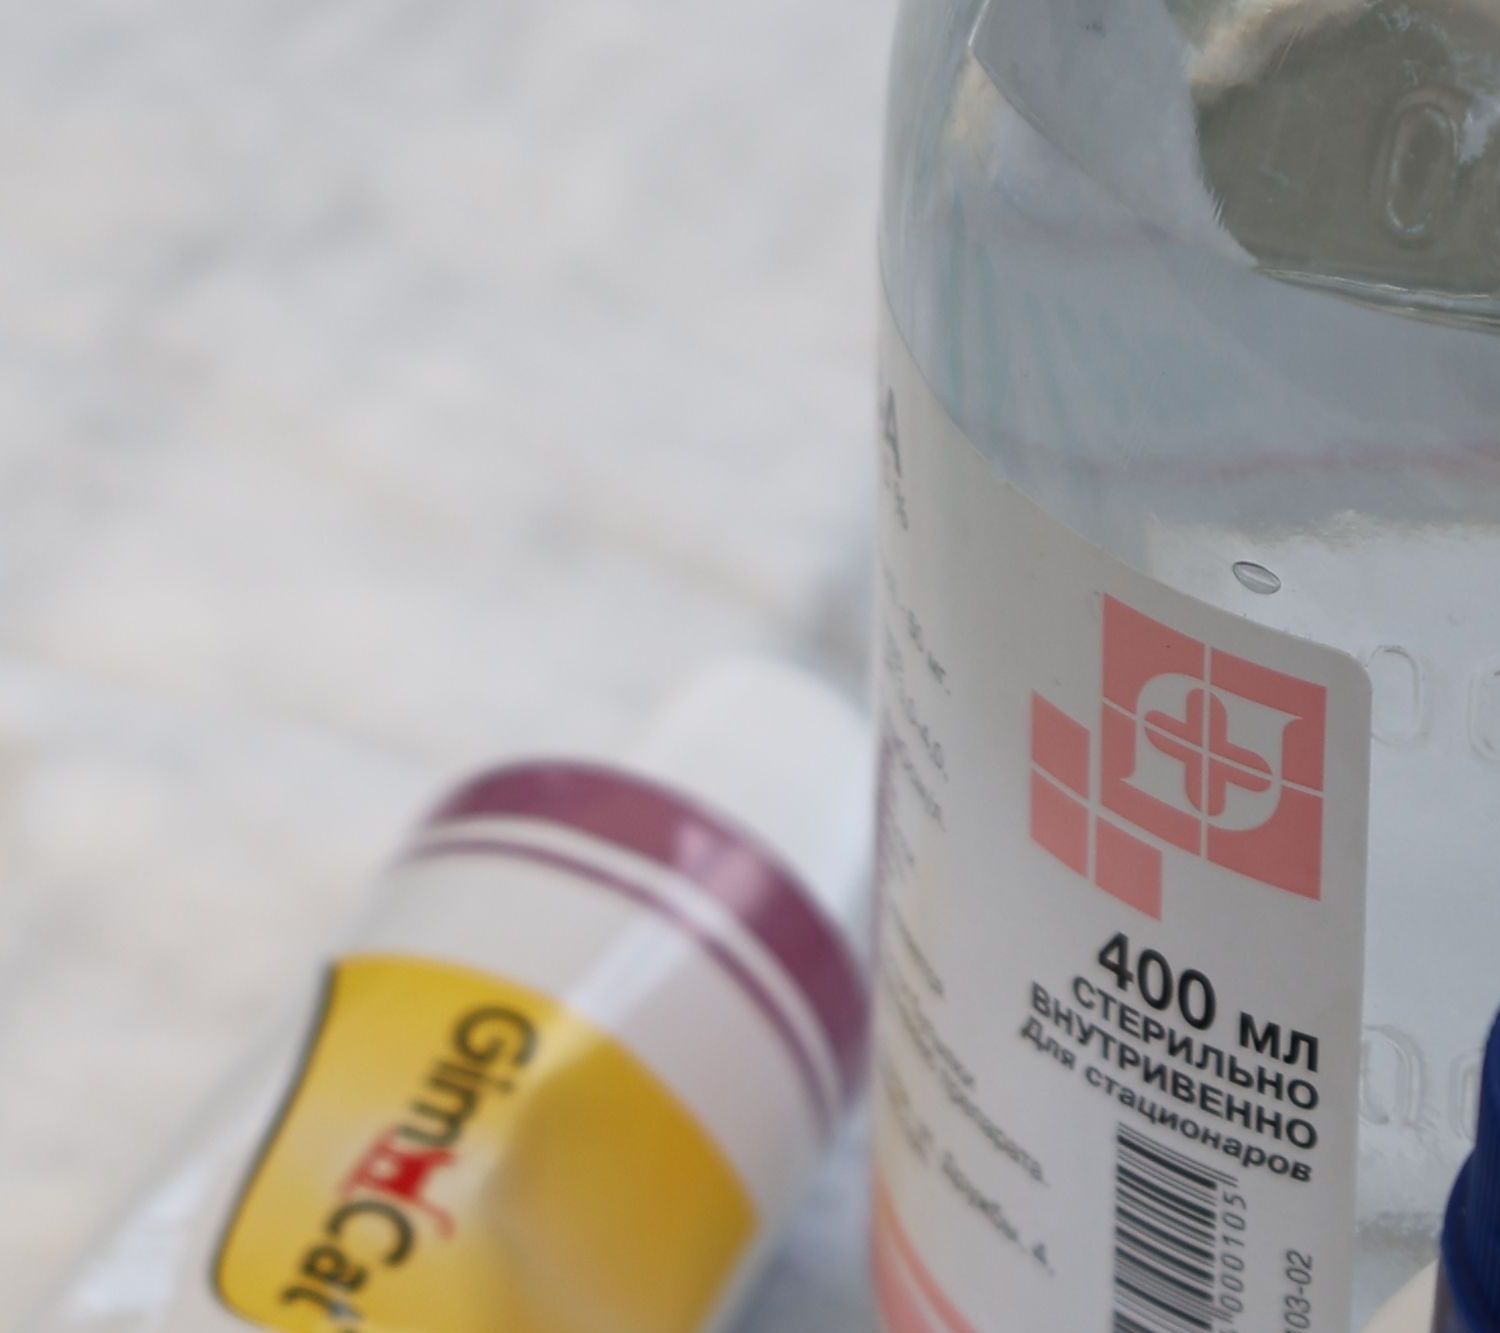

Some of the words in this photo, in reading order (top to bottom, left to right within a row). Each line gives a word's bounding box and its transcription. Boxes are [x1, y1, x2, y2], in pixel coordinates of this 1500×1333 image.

[1072, 976, 1320, 1112] СТЕРИЛЬНО
[1097, 931, 1216, 1031] 400
[1020, 1015, 1076, 1071] Для
[1085, 1065, 1312, 1184] стационаров
[1030, 981, 1319, 1151] ВНУТРИВЕННО
